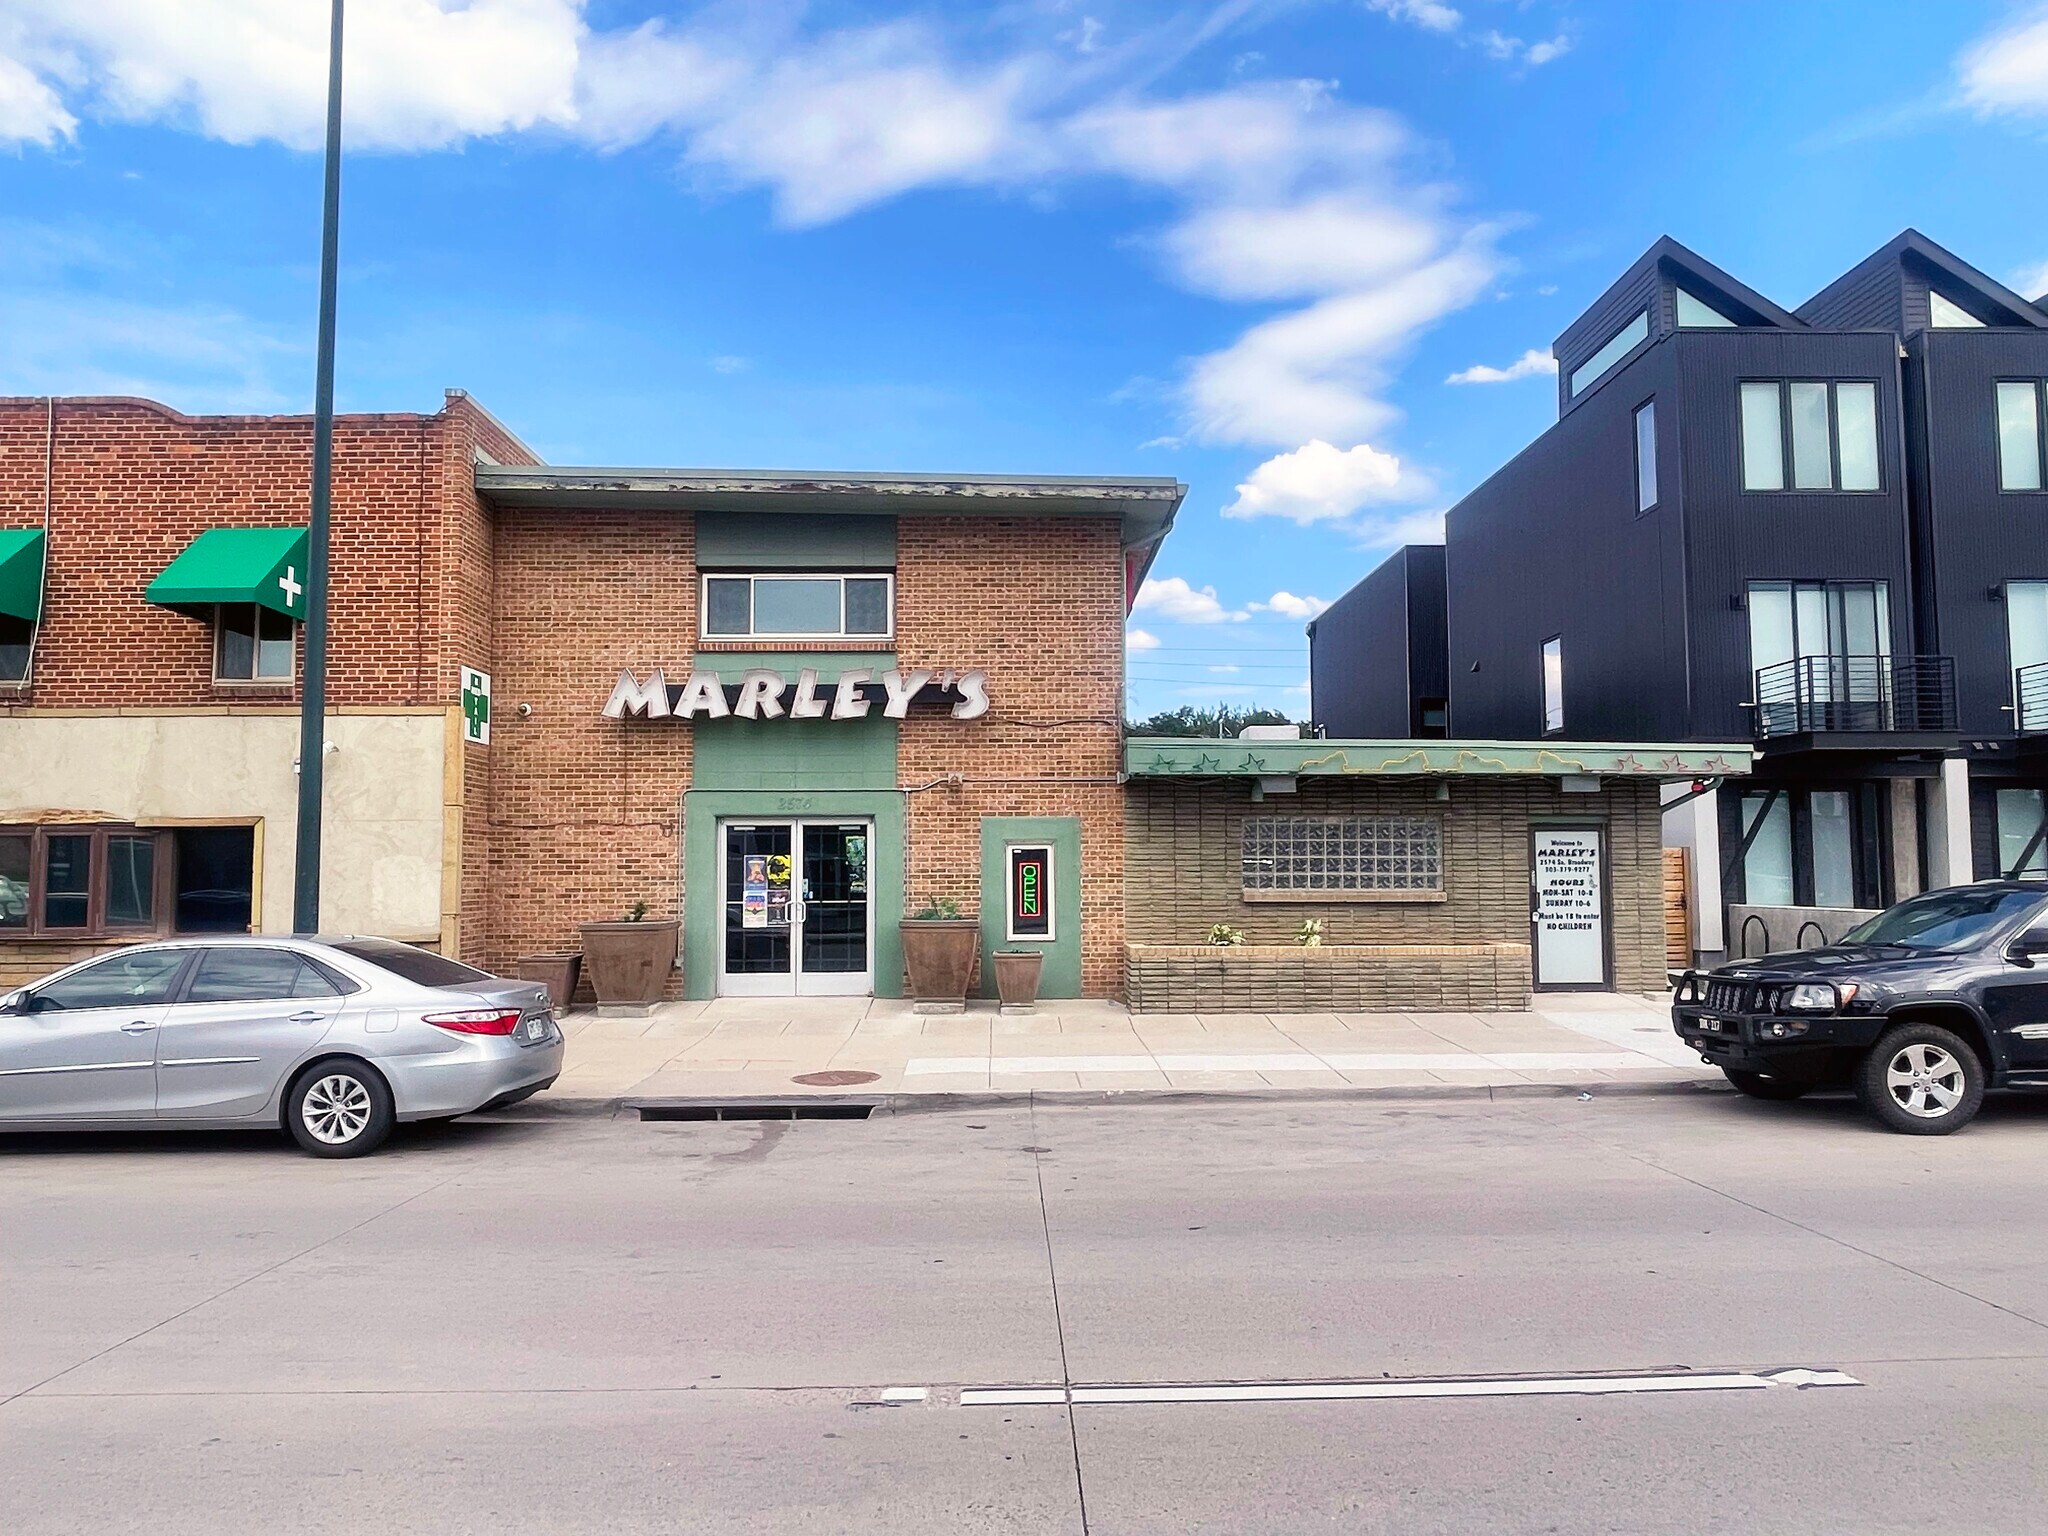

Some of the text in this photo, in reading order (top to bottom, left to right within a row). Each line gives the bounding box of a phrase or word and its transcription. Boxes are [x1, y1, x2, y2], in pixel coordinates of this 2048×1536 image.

[601, 667, 990, 720] MARLEY'S
[1538, 848, 1596, 857] MARLEY'S
[1568, 859, 1595, 867] Broadway
[1023, 865, 1036, 914] OPEN
[1546, 899, 1573, 907] SUNDAY
